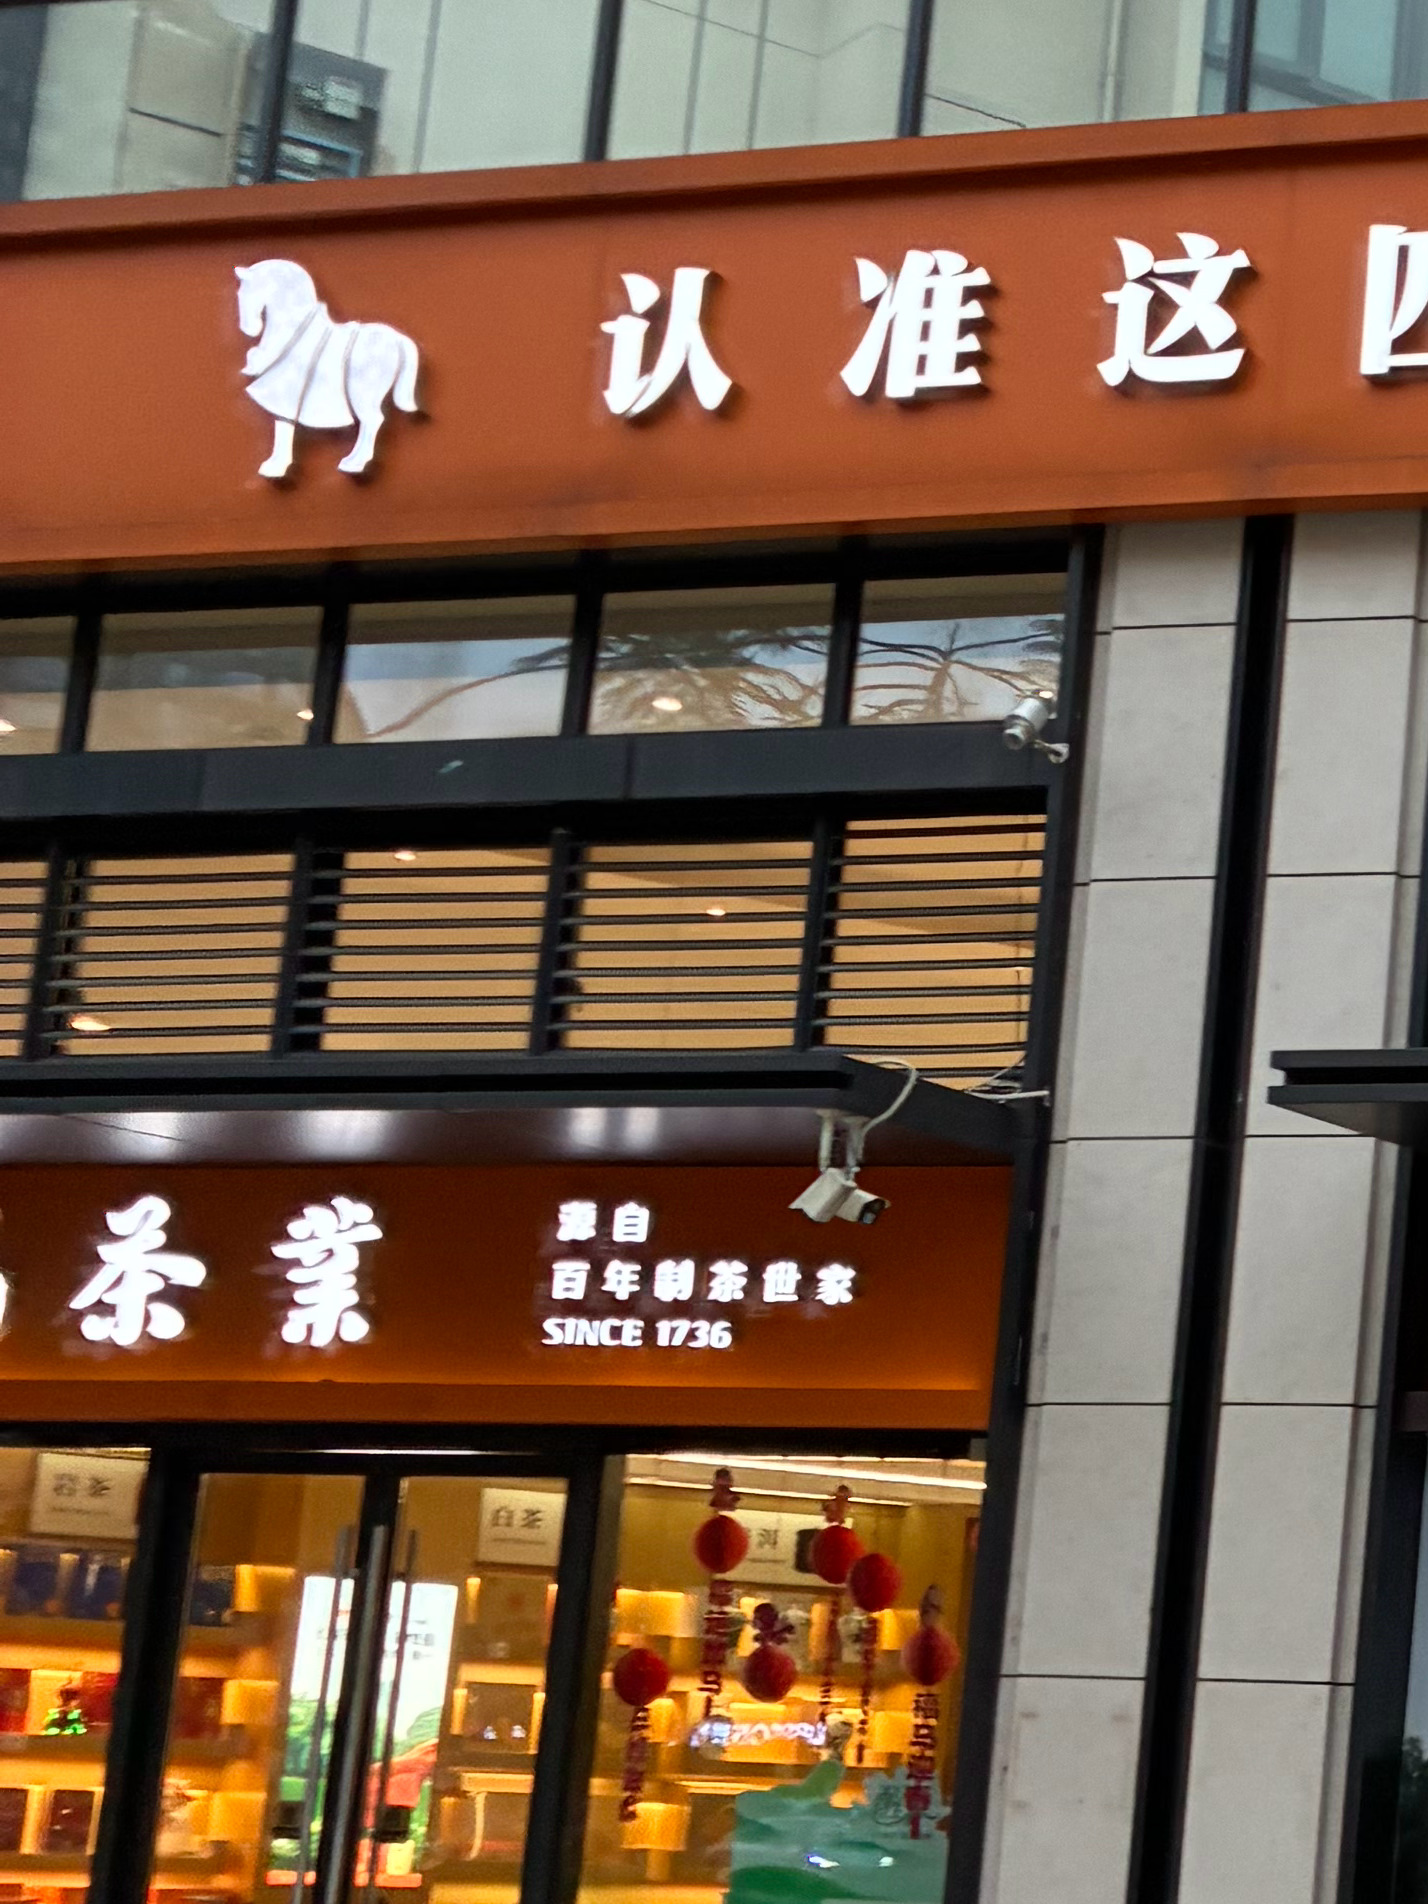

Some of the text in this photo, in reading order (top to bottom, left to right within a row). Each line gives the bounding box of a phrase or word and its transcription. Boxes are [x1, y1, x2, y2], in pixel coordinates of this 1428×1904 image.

[0, 1195, 383, 1348] 茶業
[551, 1258, 856, 1306] 百年制茶世家
[541, 1317, 733, 1349] SINCE 1736
